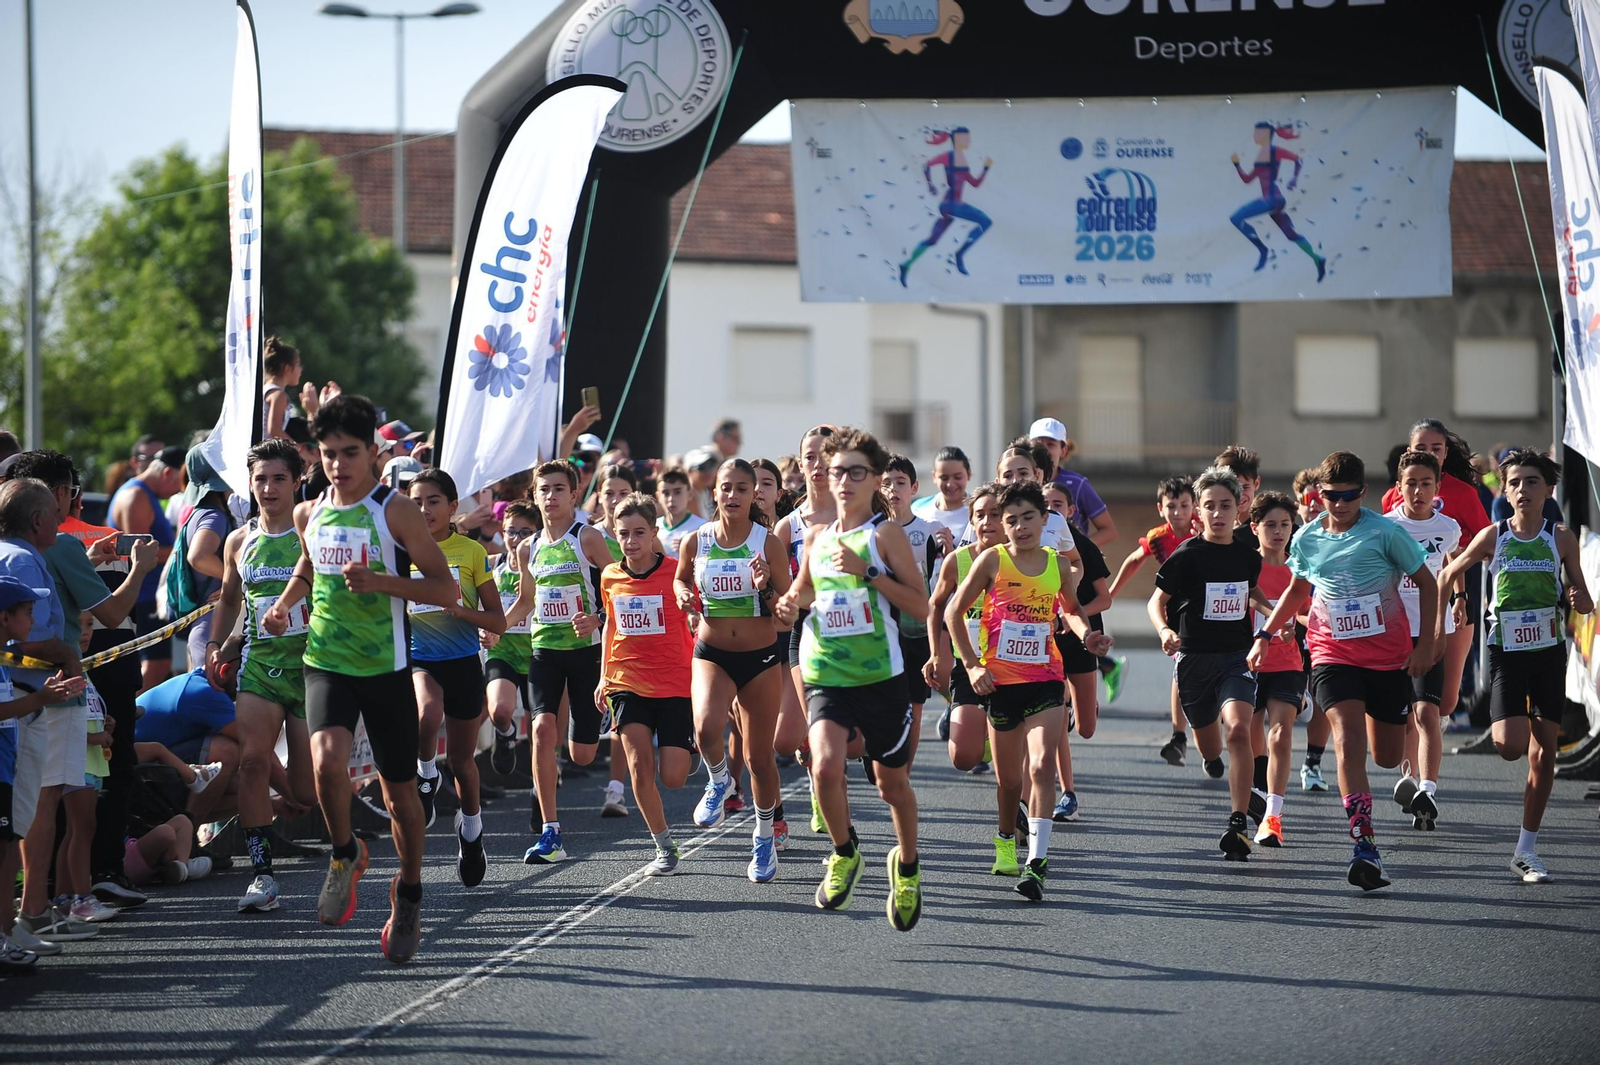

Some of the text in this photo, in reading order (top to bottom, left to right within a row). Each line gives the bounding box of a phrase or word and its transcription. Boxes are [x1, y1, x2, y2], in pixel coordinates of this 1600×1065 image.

[676, 0, 702, 23] DE
[1134, 36, 1274, 64] Deportes
[1512, 3, 1537, 88] ONSELLO
[681, 24, 718, 114] DEPORTES
[1116, 137, 1166, 146] Concello de
[1116, 147, 1175, 158] OURENSE
[1076, 234, 1156, 261] 2026
[480, 211, 538, 313] chc
[527, 224, 553, 323] energía
[319, 546, 352, 565] 3203
[243, 562, 297, 583] Natursu
[712, 576, 742, 592] 3013
[542, 602, 569, 617] 3010
[1212, 599, 1241, 614] 3044
[620, 613, 651, 628] 3034
[826, 610, 855, 628] 3014
[1336, 614, 1371, 632] 3040
[1514, 626, 1541, 644] 3011
[1006, 639, 1039, 657] 3028
